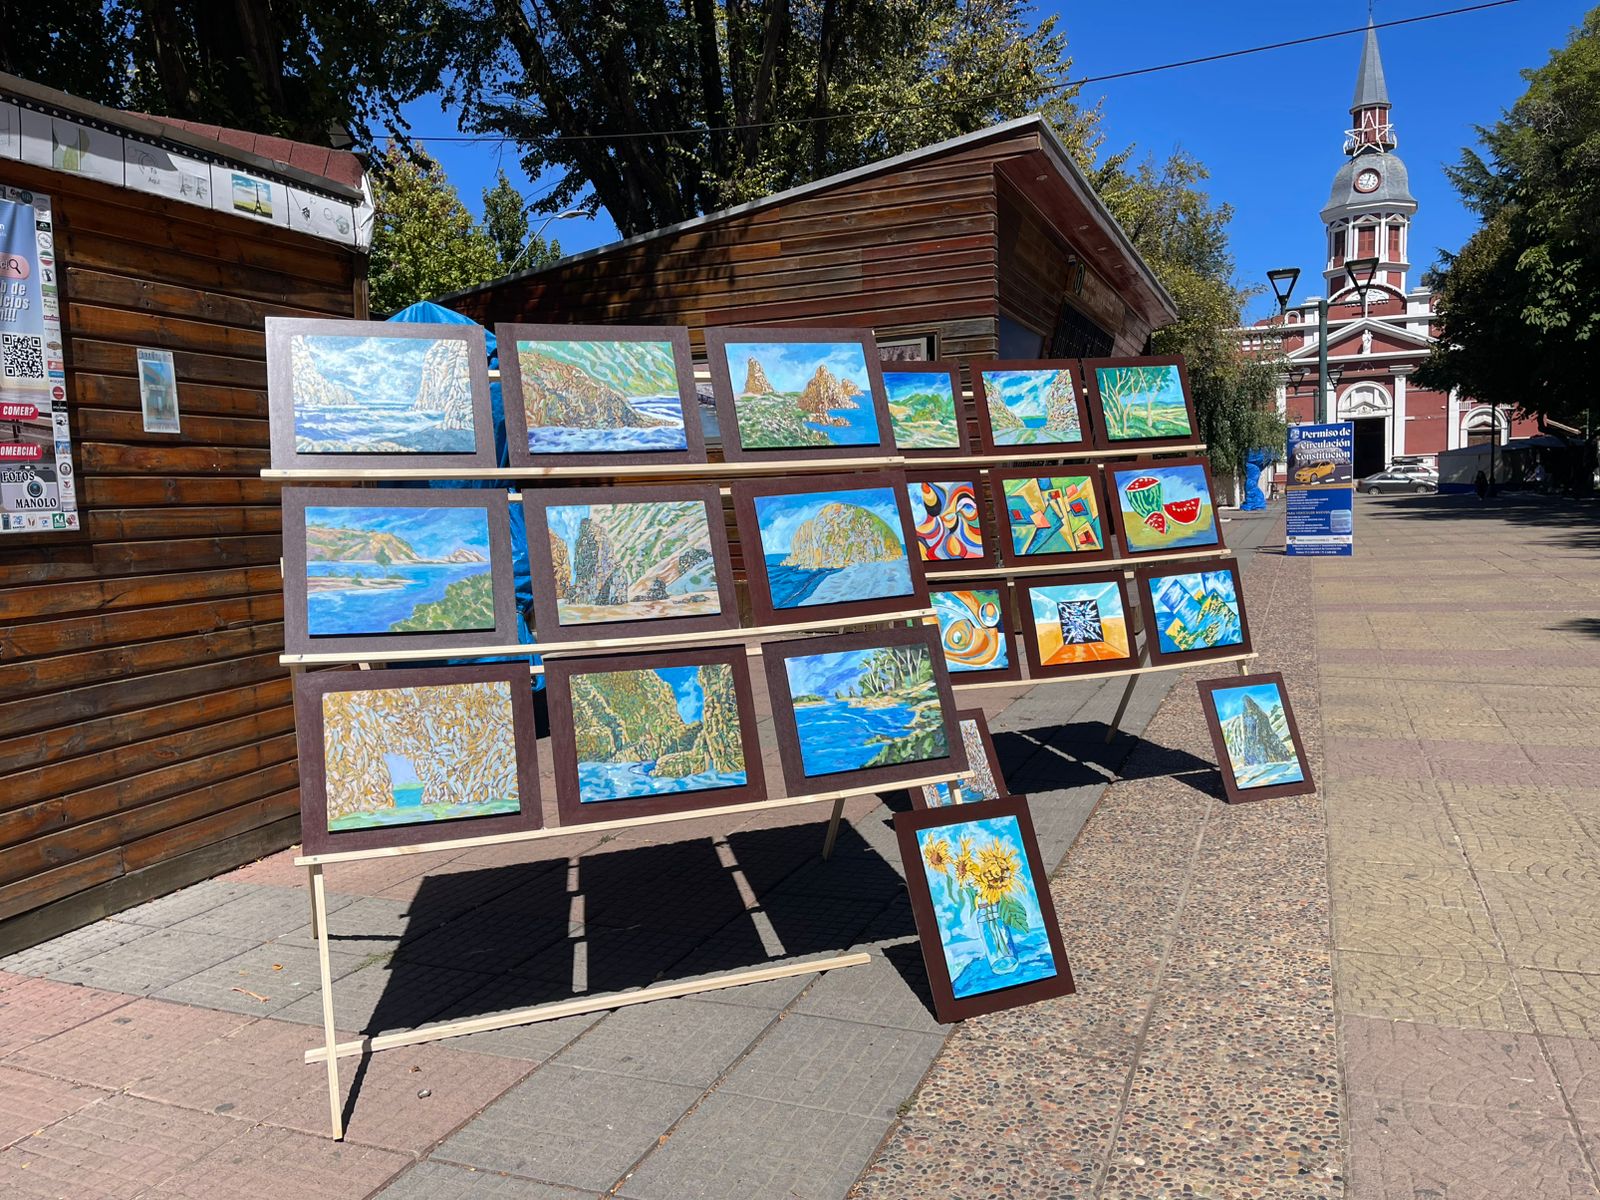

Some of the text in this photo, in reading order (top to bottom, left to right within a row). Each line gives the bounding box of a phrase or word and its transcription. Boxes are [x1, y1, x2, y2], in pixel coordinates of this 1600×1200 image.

[11, 281, 26, 296] de
[3, 405, 35, 416] COMER?
[1302, 427, 1351, 439] Permiso de
[1300, 438, 1350, 449] Circulación
[0, 445, 38, 456] OMERCIAL
[2, 470, 35, 481] FOTOS
[15, 498, 57, 509] MANOLO
